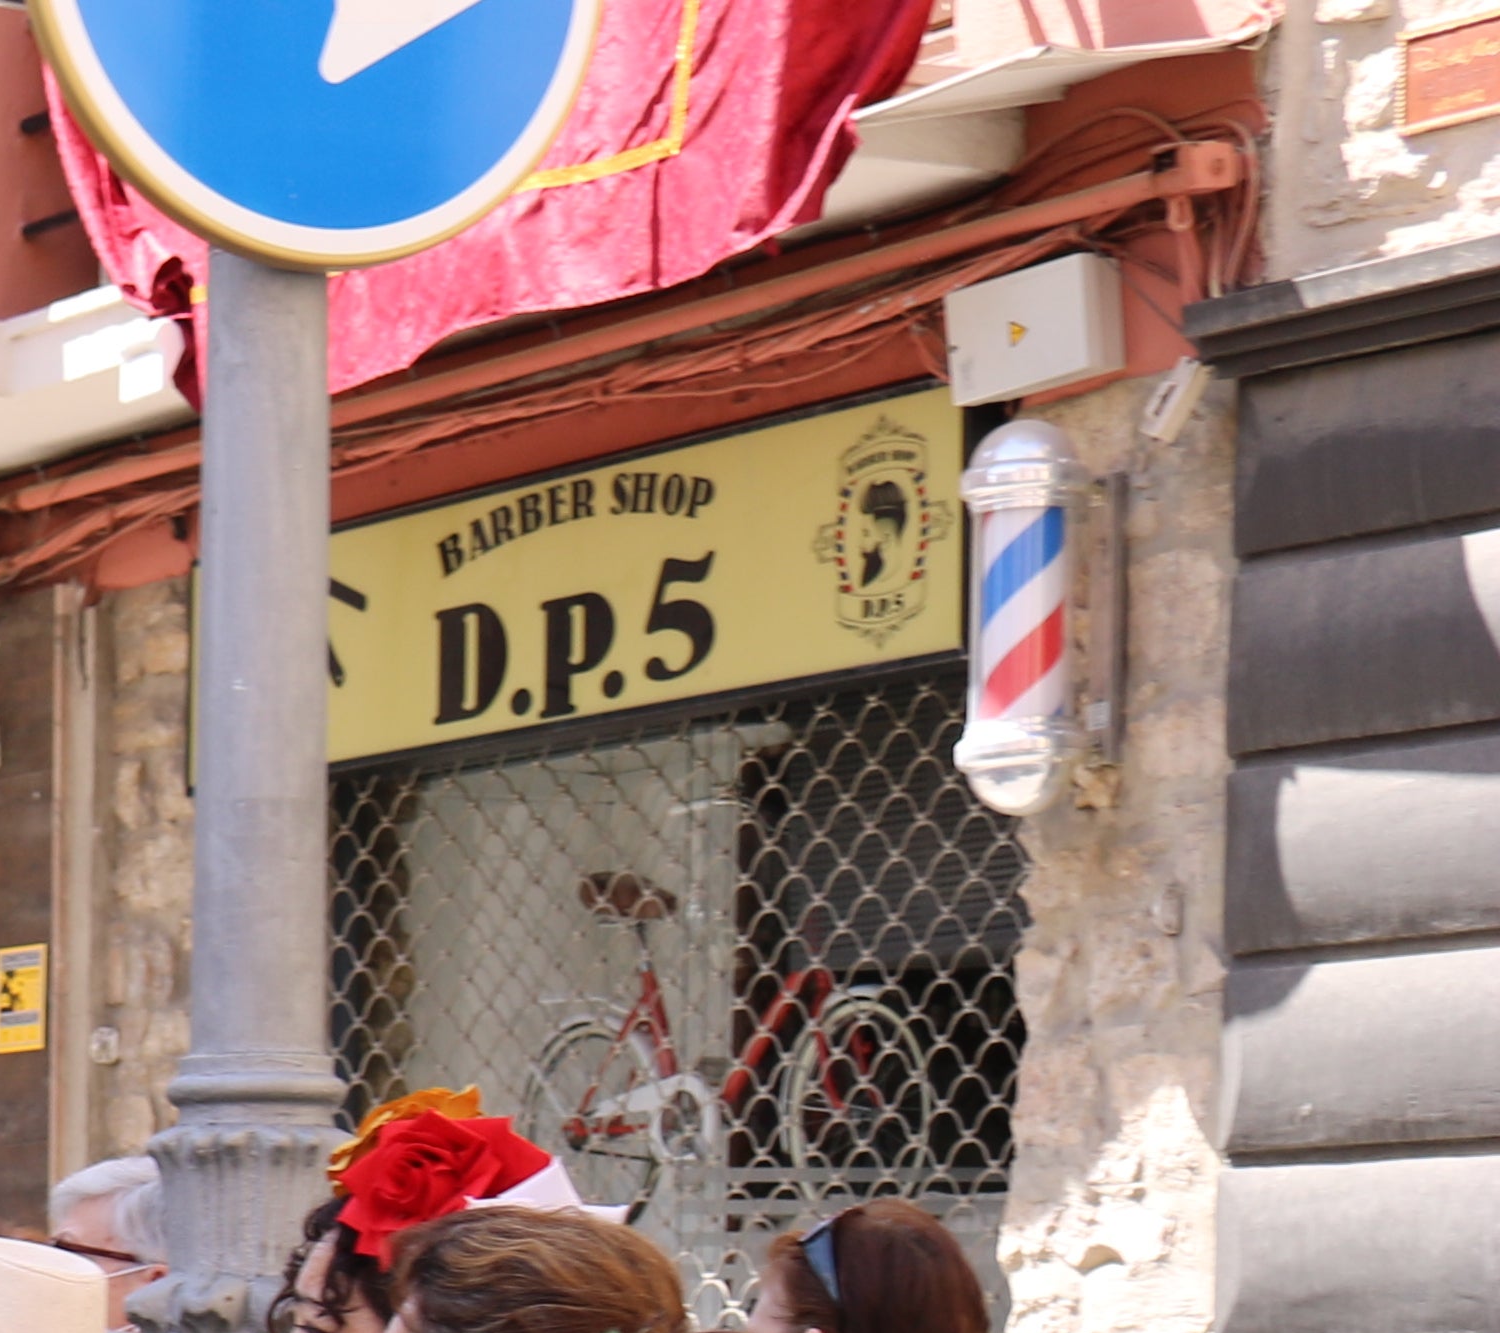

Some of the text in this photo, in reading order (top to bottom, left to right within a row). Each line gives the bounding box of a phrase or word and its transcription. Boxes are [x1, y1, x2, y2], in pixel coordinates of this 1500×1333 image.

[436, 472, 716, 578] BARBER SHOP
[433, 550, 716, 726] D.P.5
